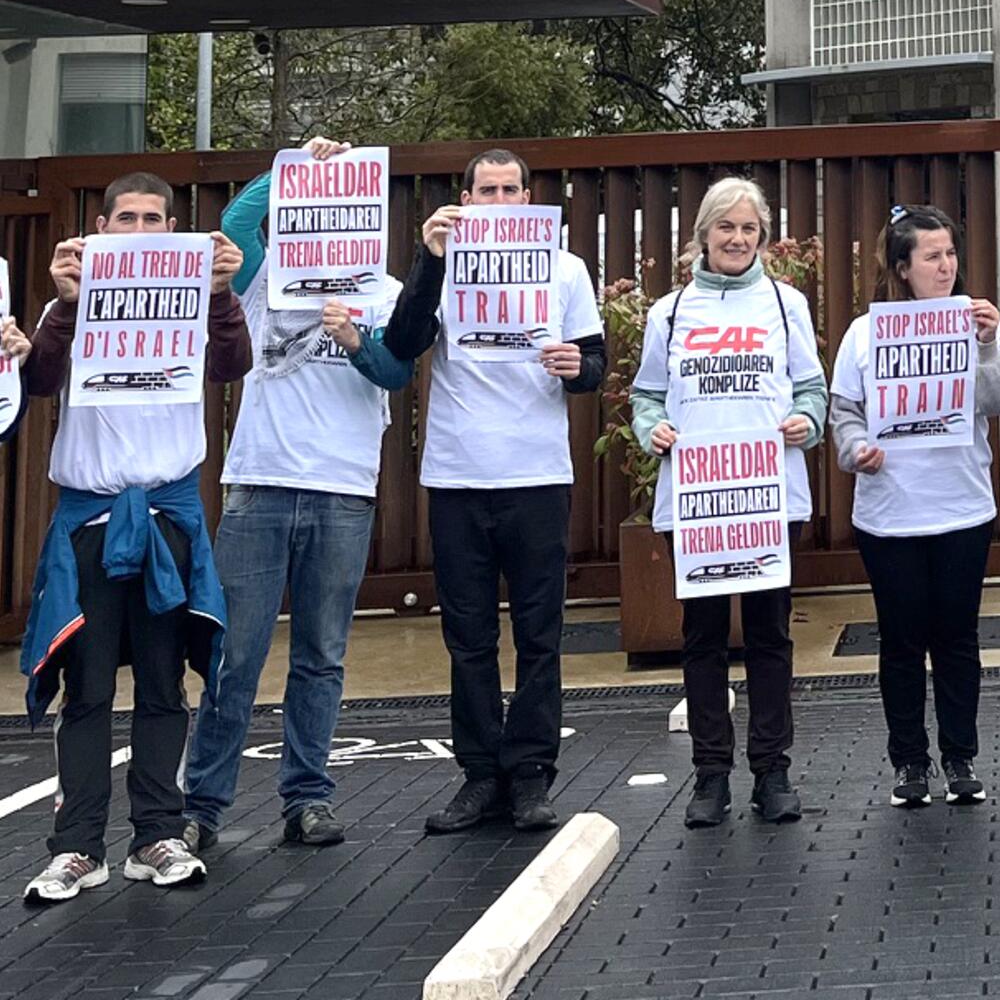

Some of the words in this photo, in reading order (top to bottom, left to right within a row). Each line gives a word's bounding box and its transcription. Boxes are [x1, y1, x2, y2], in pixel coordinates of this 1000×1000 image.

[279, 161, 382, 200] ISRAELDAR
[279, 206, 381, 233] APARTHEIDAREN
[454, 217, 489, 243] STOP
[494, 217, 552, 242] ISRAEL'S
[93, 252, 115, 280] NO
[118, 251, 135, 279] AL
[141, 251, 181, 278] TREN
[185, 251, 203, 278] DE
[278, 240, 323, 268] TRENA
[327, 239, 380, 266] GELDITU
[455, 251, 550, 283] APARTHEID
[88, 288, 199, 321] L'APARTHEID
[455, 290, 548, 323] TRAIN
[876, 313, 910, 339] STOP
[914, 309, 970, 336] ISRAEL'S
[684, 327, 768, 354] CAF
[680, 355, 774, 378] GENOZIDIOAREN
[877, 341, 968, 379] APARTHEID
[698, 374, 760, 394] KONPLIZE
[877, 378, 965, 418] TRAIN
[678, 440, 778, 485] ISRAELDAR
[680, 486, 780, 519] APARTHEIDAREN
[680, 526, 724, 554] TRENA
[727, 520, 781, 550] GELDITU
